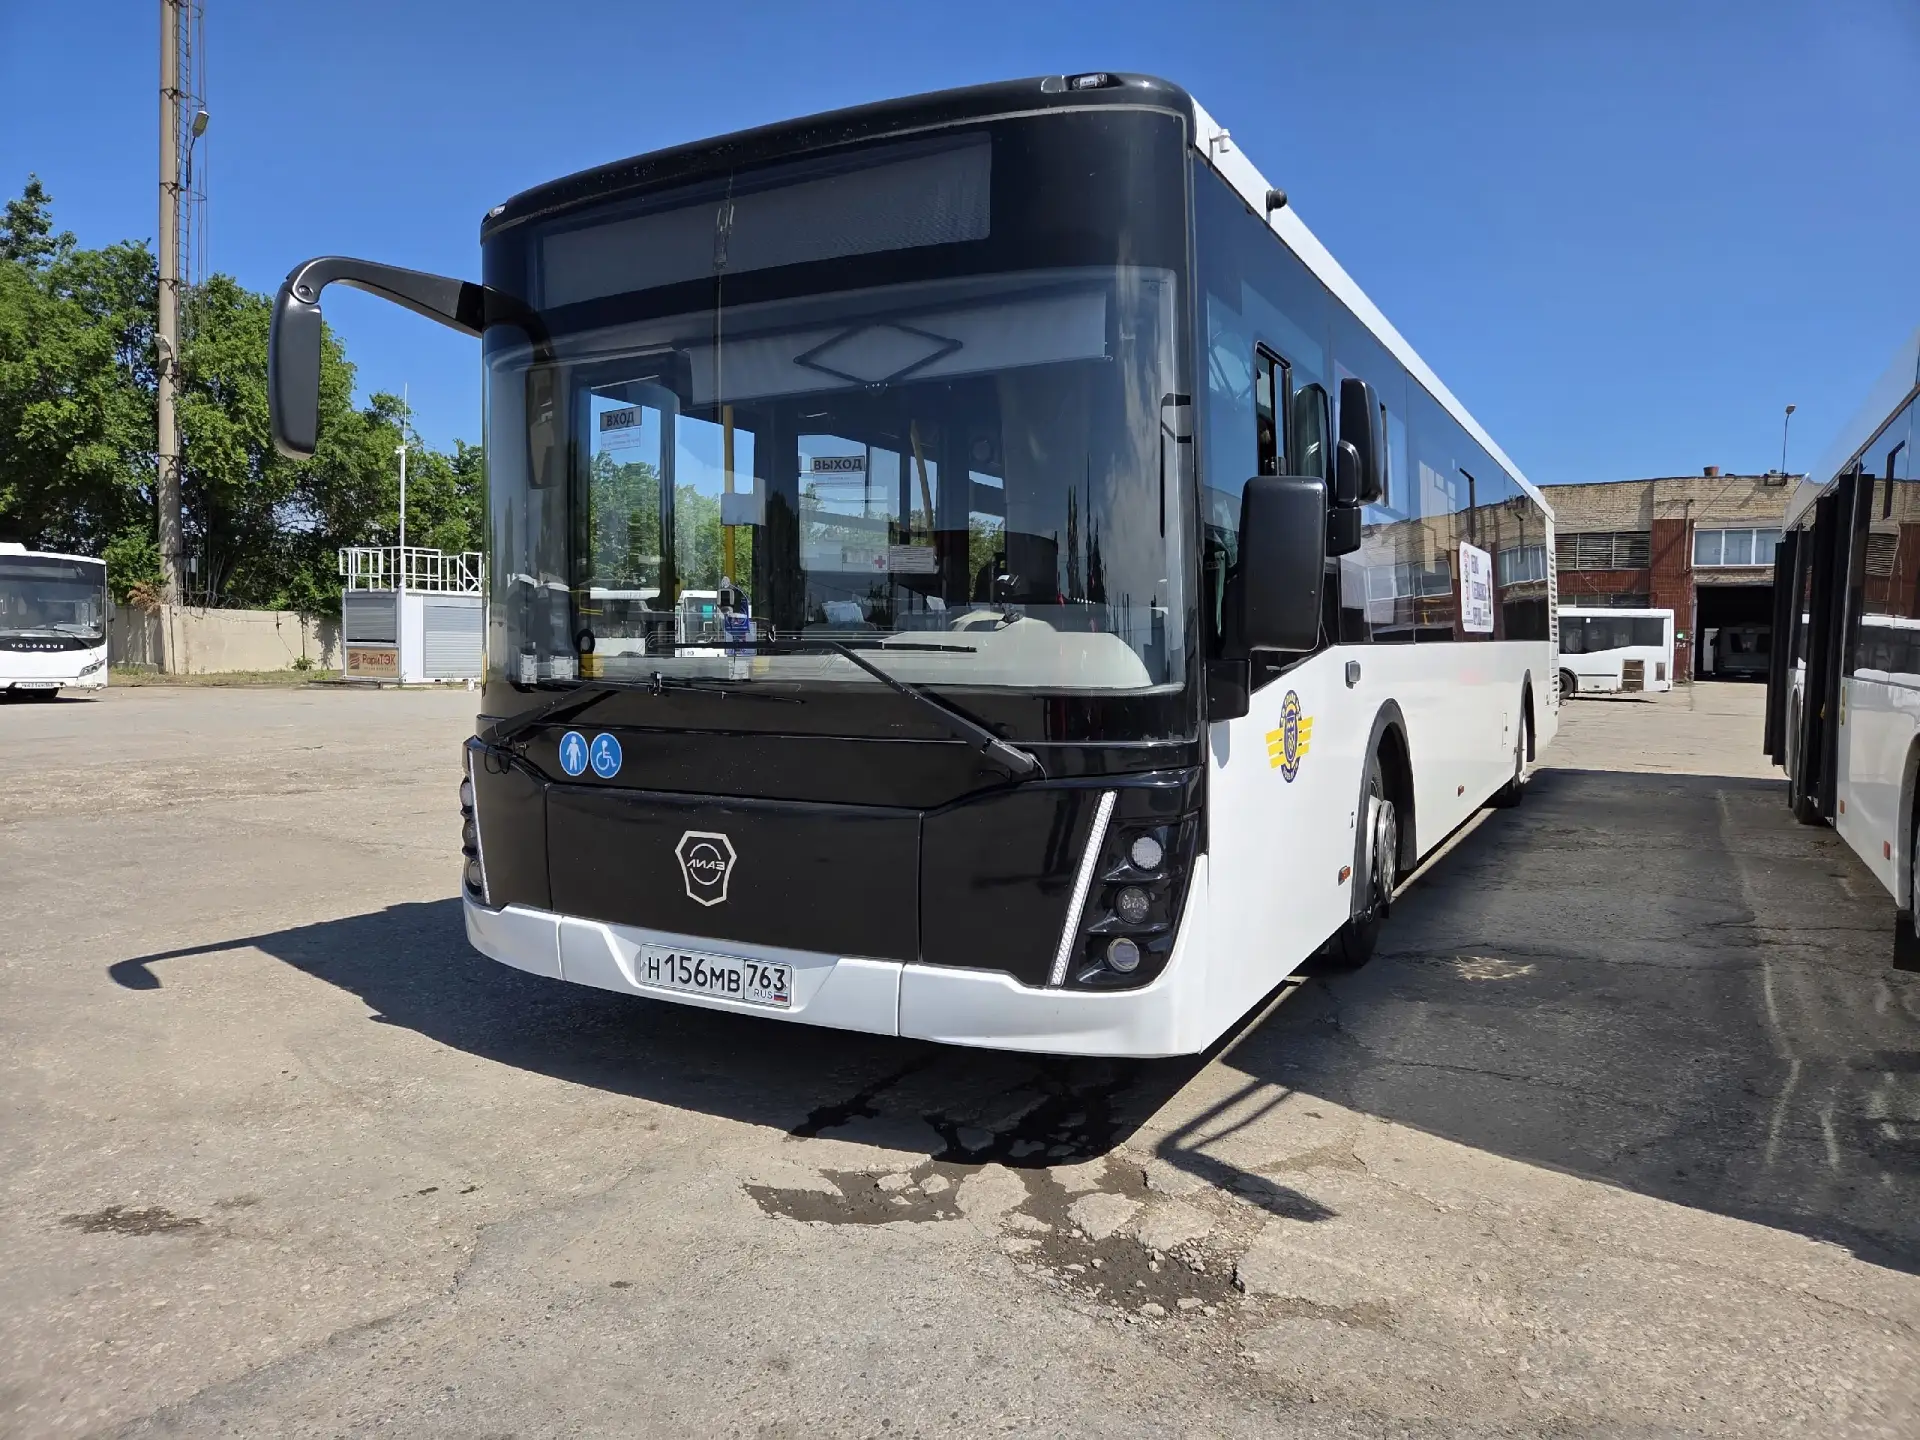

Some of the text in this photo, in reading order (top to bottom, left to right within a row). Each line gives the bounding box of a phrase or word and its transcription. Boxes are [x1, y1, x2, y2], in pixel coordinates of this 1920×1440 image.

[606, 411, 635, 427] ВХОД
[814, 459, 862, 471] ВЫХОД
[648, 953, 787, 993] Н156МВ 763
[753, 988, 773, 999] RUS
